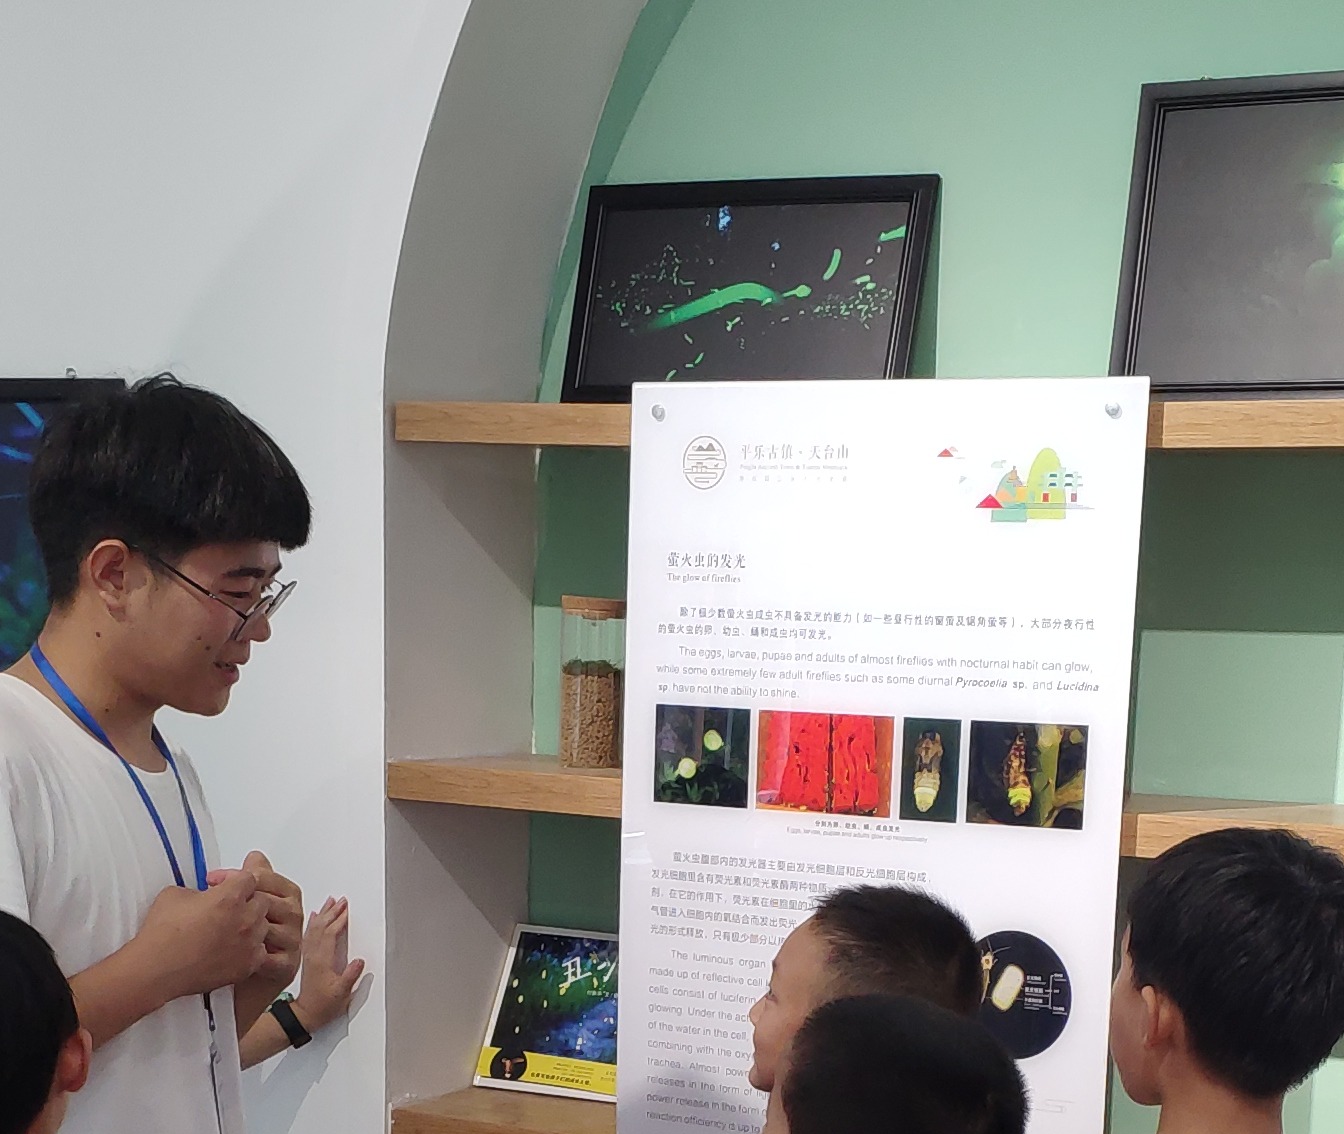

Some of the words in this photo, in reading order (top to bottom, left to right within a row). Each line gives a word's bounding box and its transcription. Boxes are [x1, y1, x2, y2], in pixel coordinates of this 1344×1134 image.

[667, 552, 746, 569] 萤火虫的发光
[670, 950, 689, 960] The
[692, 953, 734, 965] luminous
[738, 959, 766, 969] organ
